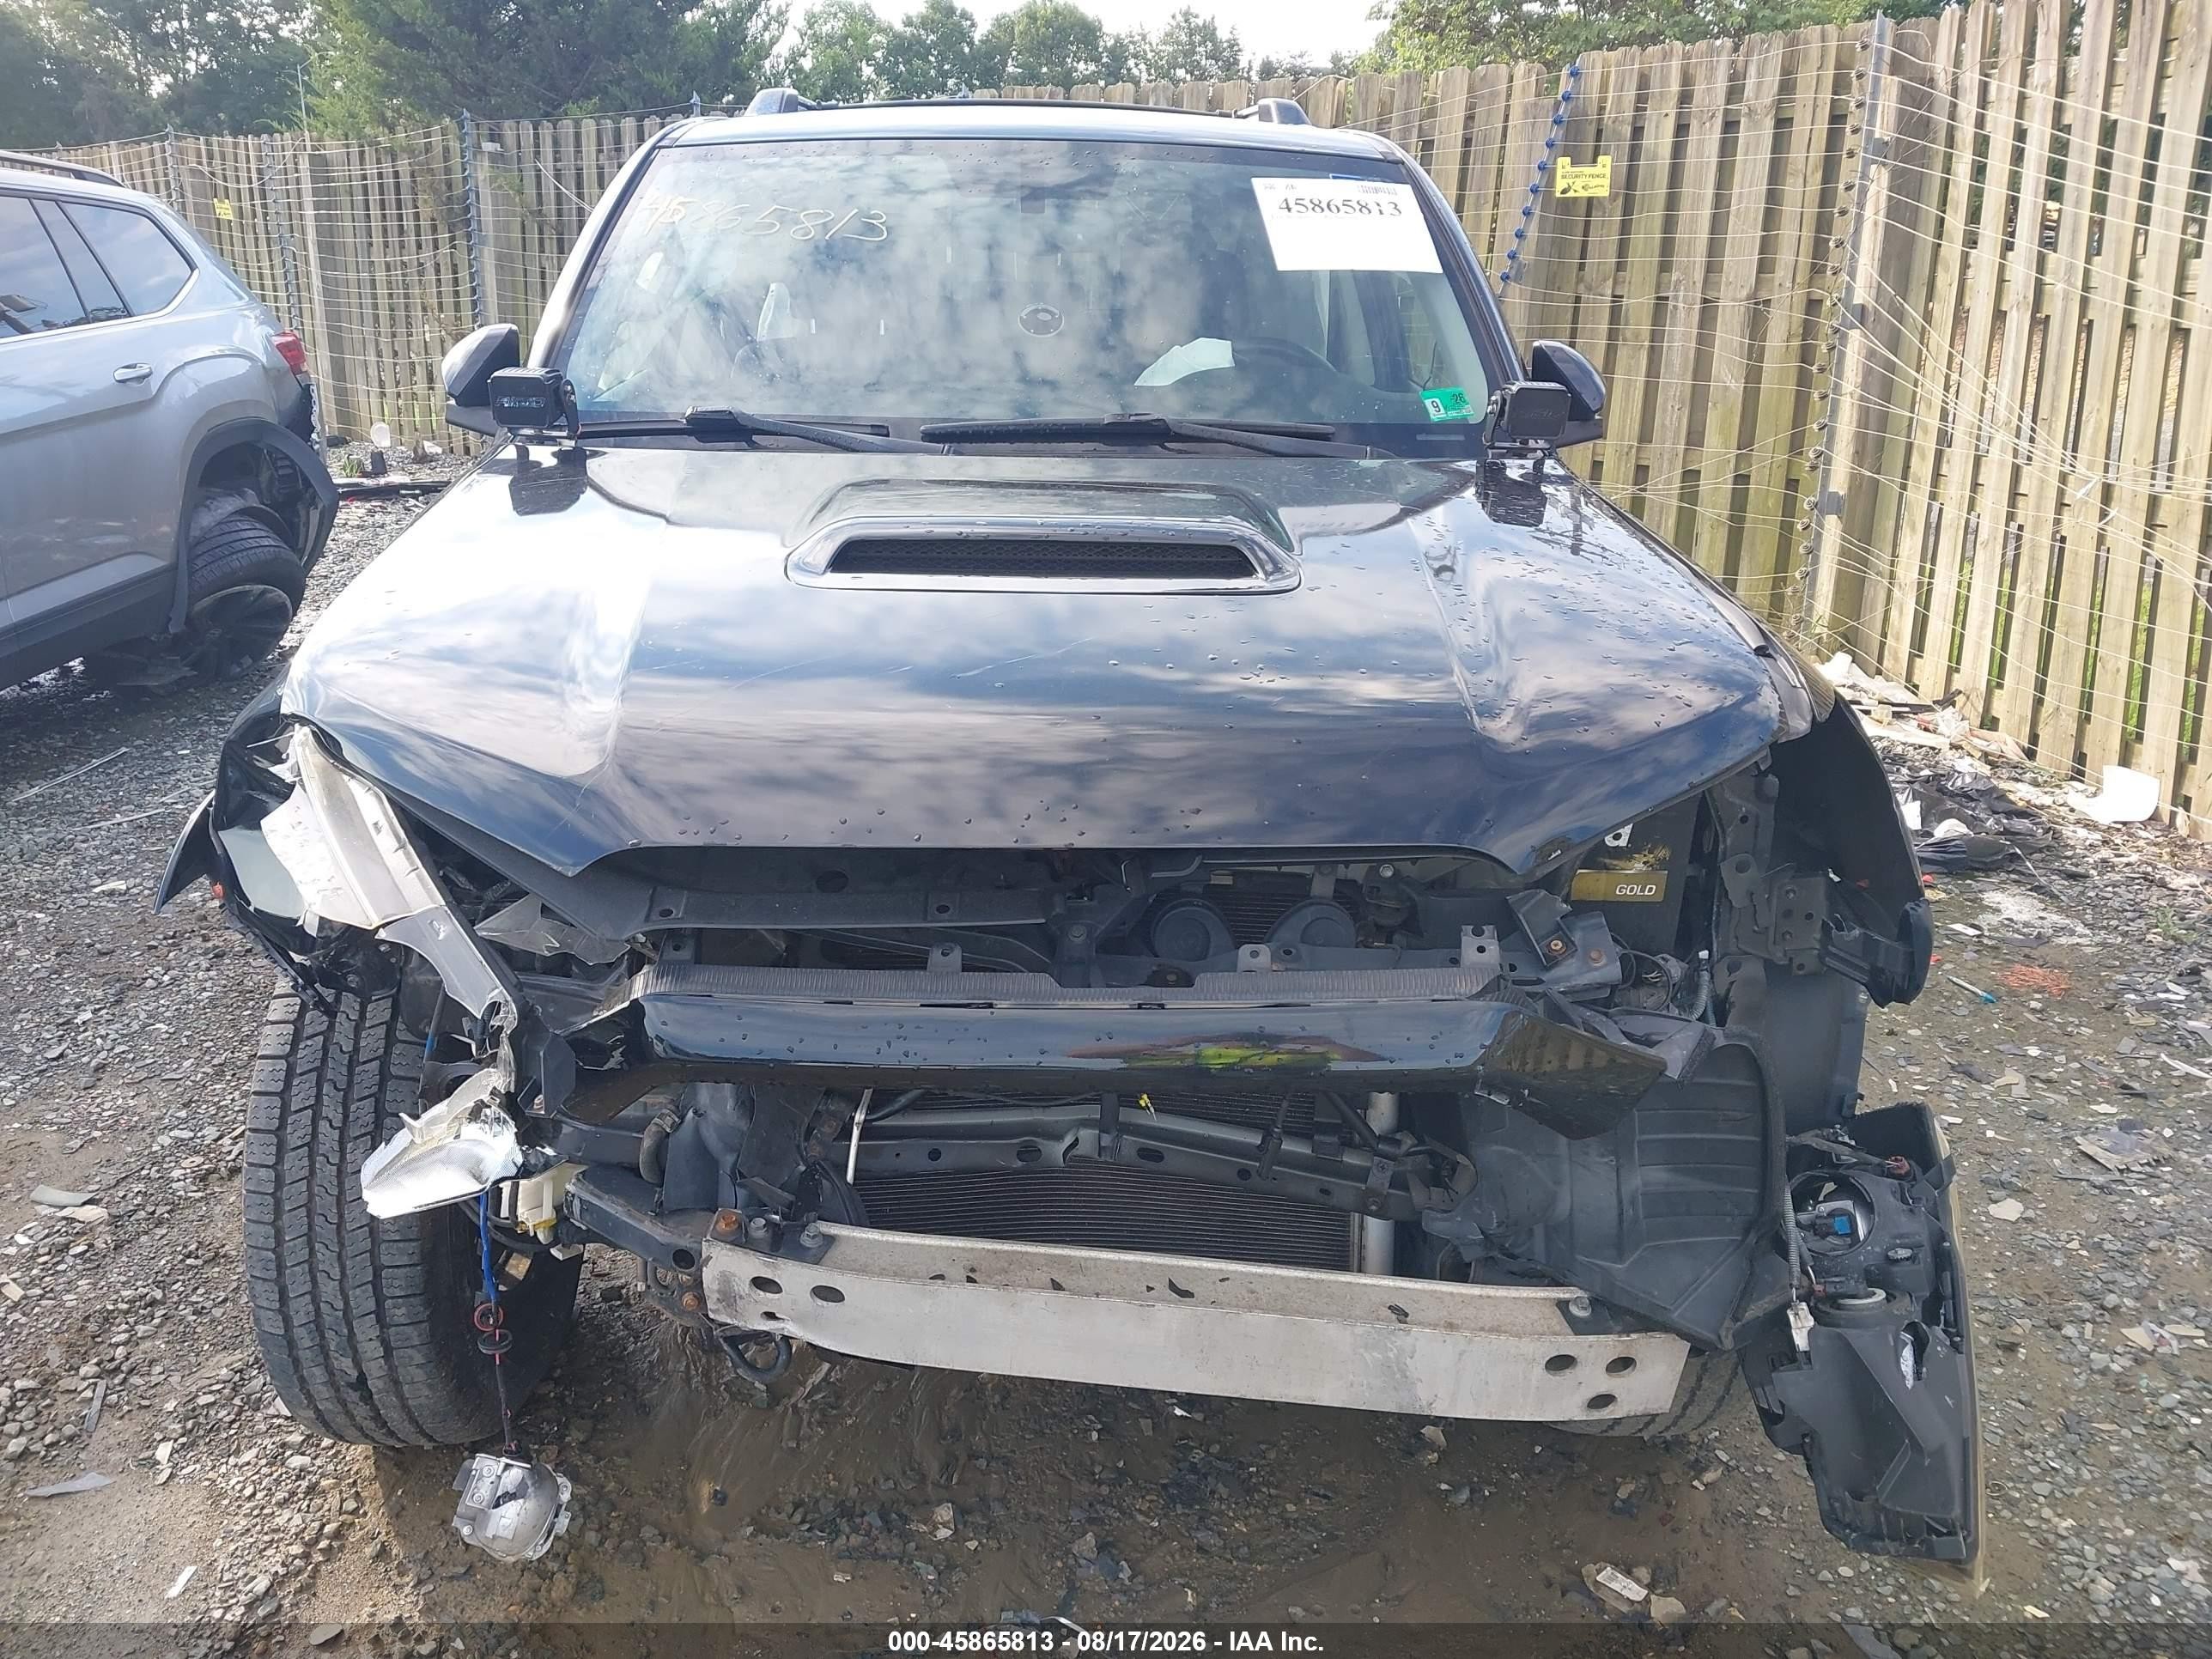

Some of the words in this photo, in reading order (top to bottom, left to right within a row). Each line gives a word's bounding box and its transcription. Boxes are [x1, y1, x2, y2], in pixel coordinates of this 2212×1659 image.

[1279, 198, 1402, 216] 45865813
[1431, 400, 1441, 412] 9
[1615, 884, 1656, 895] GOLD
